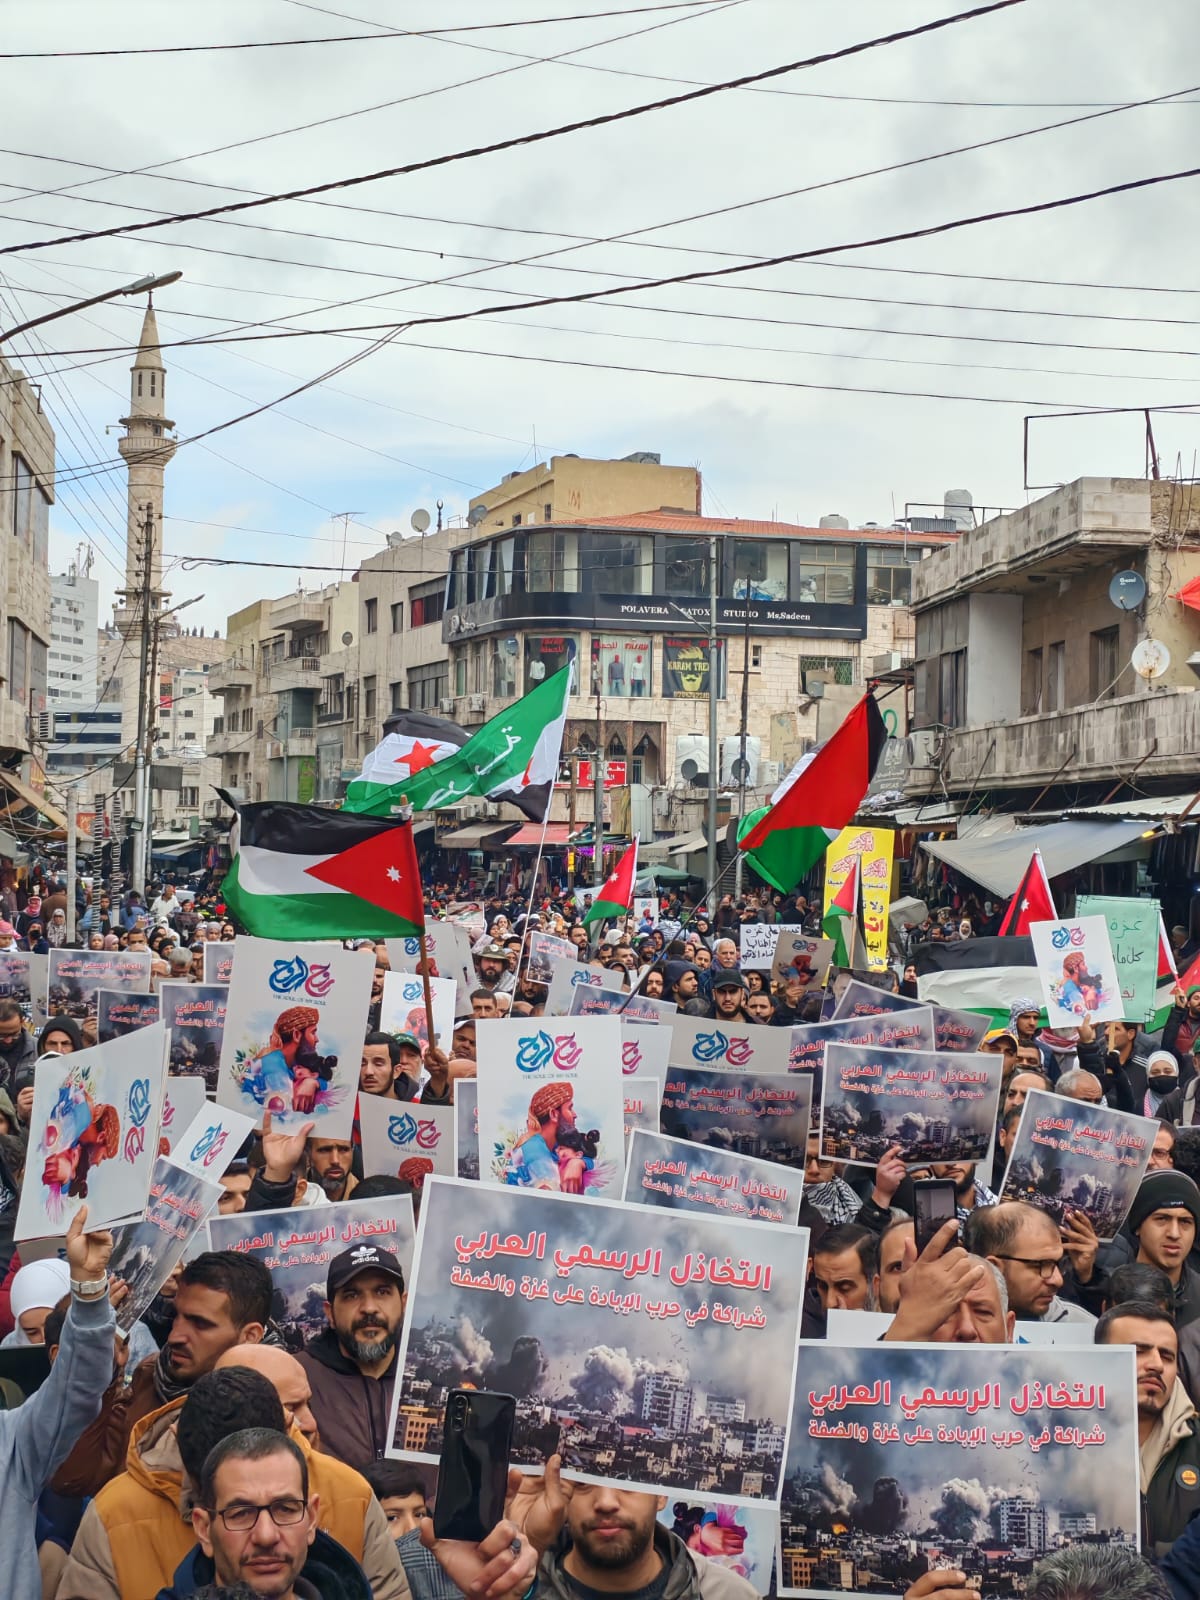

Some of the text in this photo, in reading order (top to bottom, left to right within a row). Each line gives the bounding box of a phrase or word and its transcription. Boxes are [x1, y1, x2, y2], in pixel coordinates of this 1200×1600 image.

[621, 605, 669, 614] POLAVERA
[269, 954, 308, 994] الروح
[305, 962, 336, 998] روح
[516, 1030, 583, 1073] روح الروح
[692, 1029, 755, 1066] روح الروح
[664, 1081, 796, 1102] التخاذل الرسمي الع
[839, 1064, 988, 1084] التخاذل الرسمي العربي
[388, 1112, 442, 1149] روح الروح
[644, 1158, 788, 1202] التخاذل الرسمي العربي
[277, 1225, 336, 1253] الرسمي
[340, 1218, 398, 1243] التخاذل
[351, 1254, 380, 1265] adidas
[454, 1230, 772, 1291] التخاذل الرسمي العربي
[450, 1267, 767, 1329] شراكة في حرب الإبادة على غزة والضفة
[807, 1379, 1106, 1419] التخاذل الرسمي العربي
[807, 1418, 1106, 1453] شراكة في حرب الإبادة على غزة والضفة
